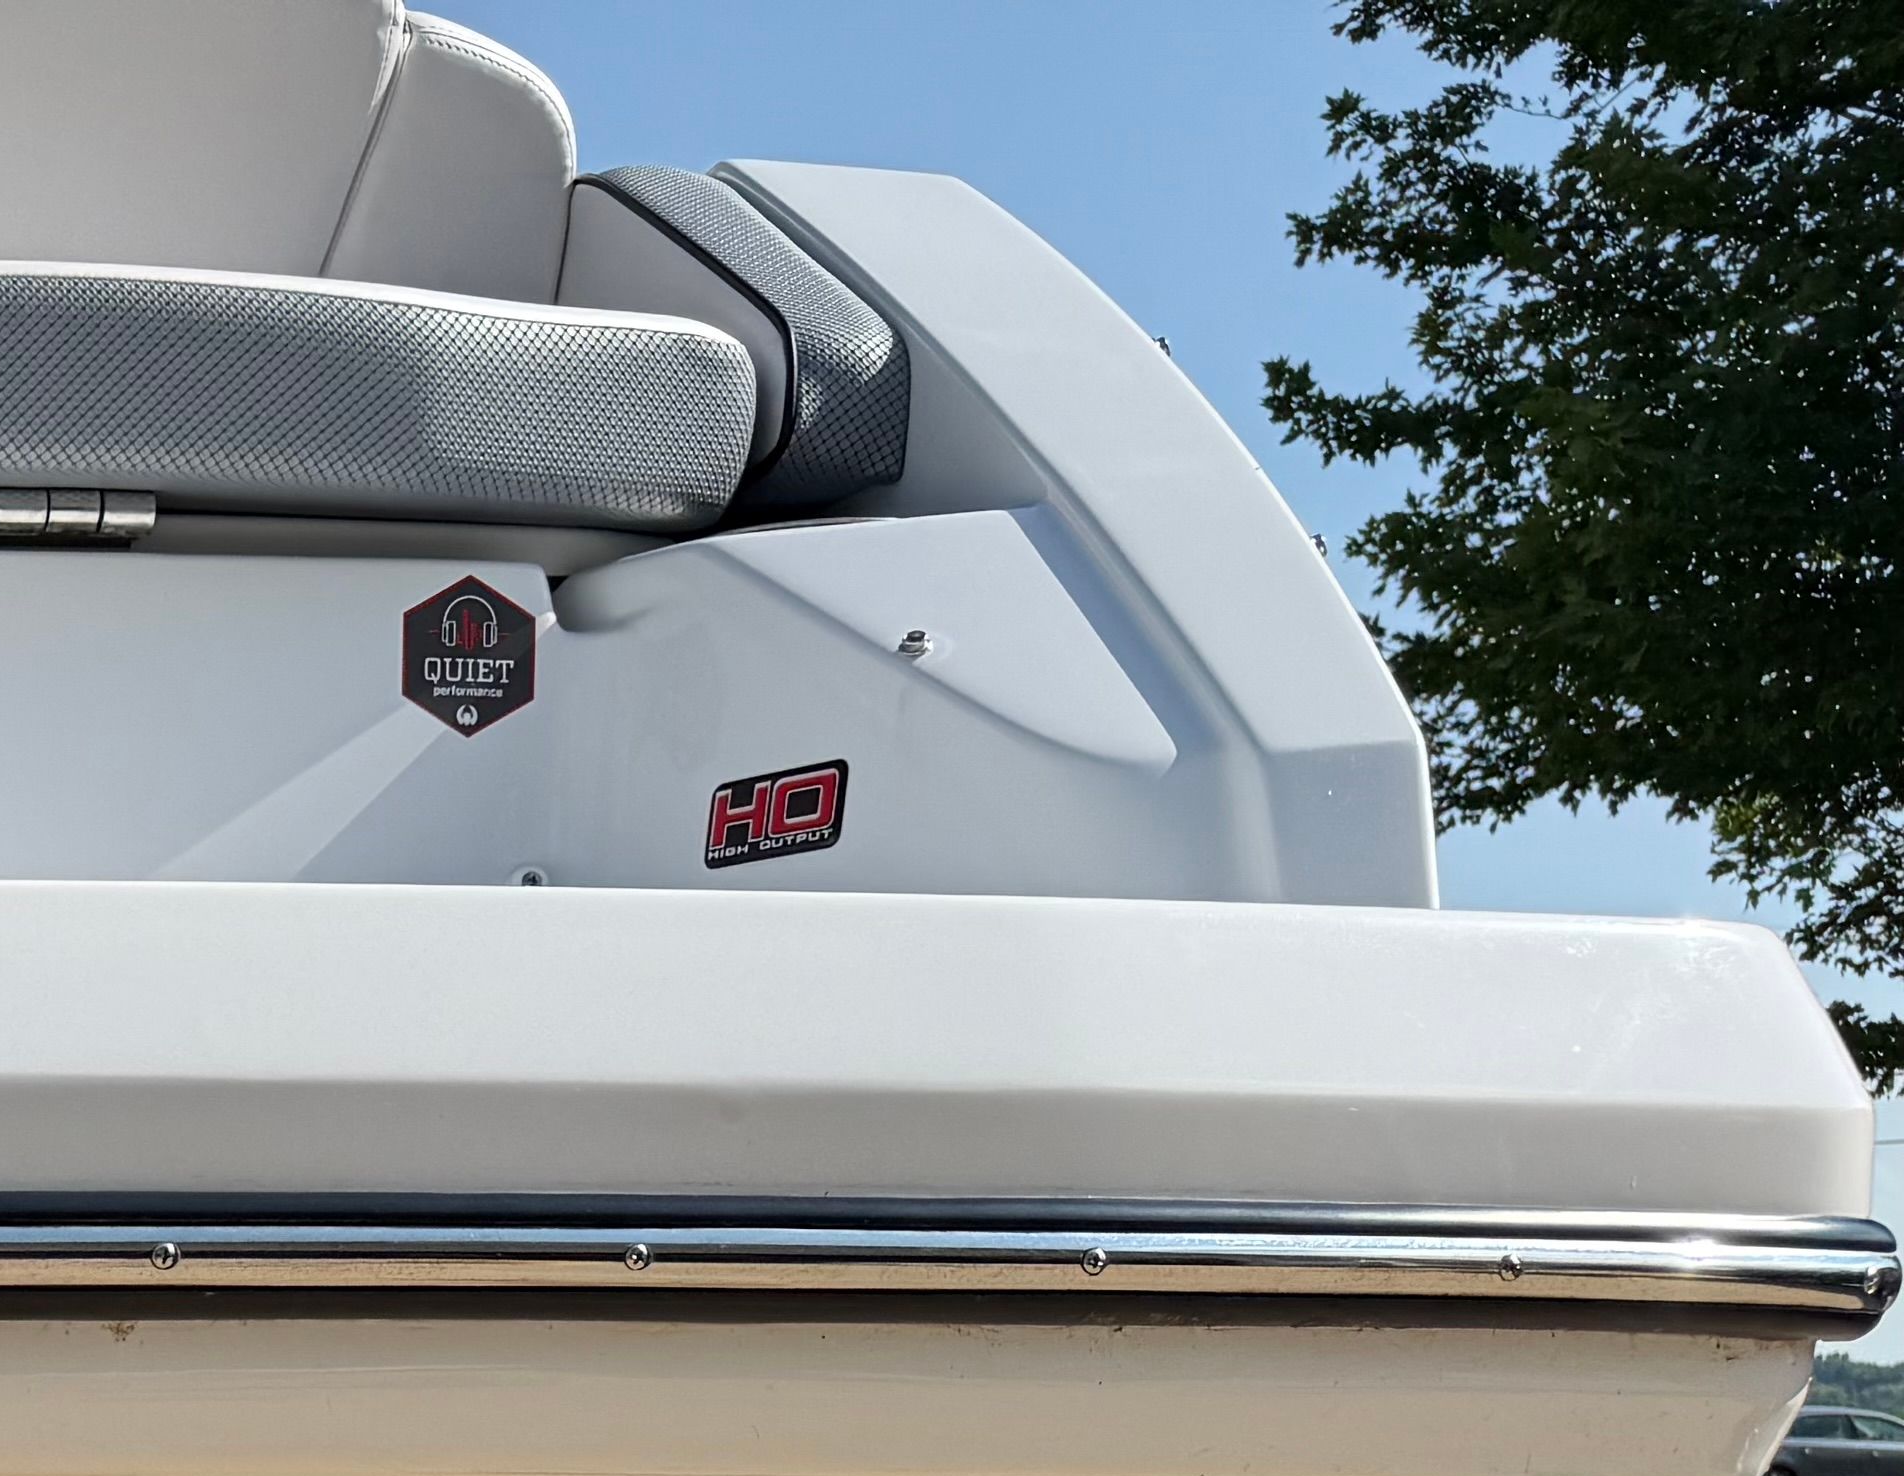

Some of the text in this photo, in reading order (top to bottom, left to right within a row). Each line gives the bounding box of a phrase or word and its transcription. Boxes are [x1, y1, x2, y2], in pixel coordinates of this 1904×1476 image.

[424, 657, 514, 684] QUIET
[433, 685, 503, 698] performance
[708, 768, 839, 850] HO
[708, 828, 834, 861] HIGH OUTPUT
